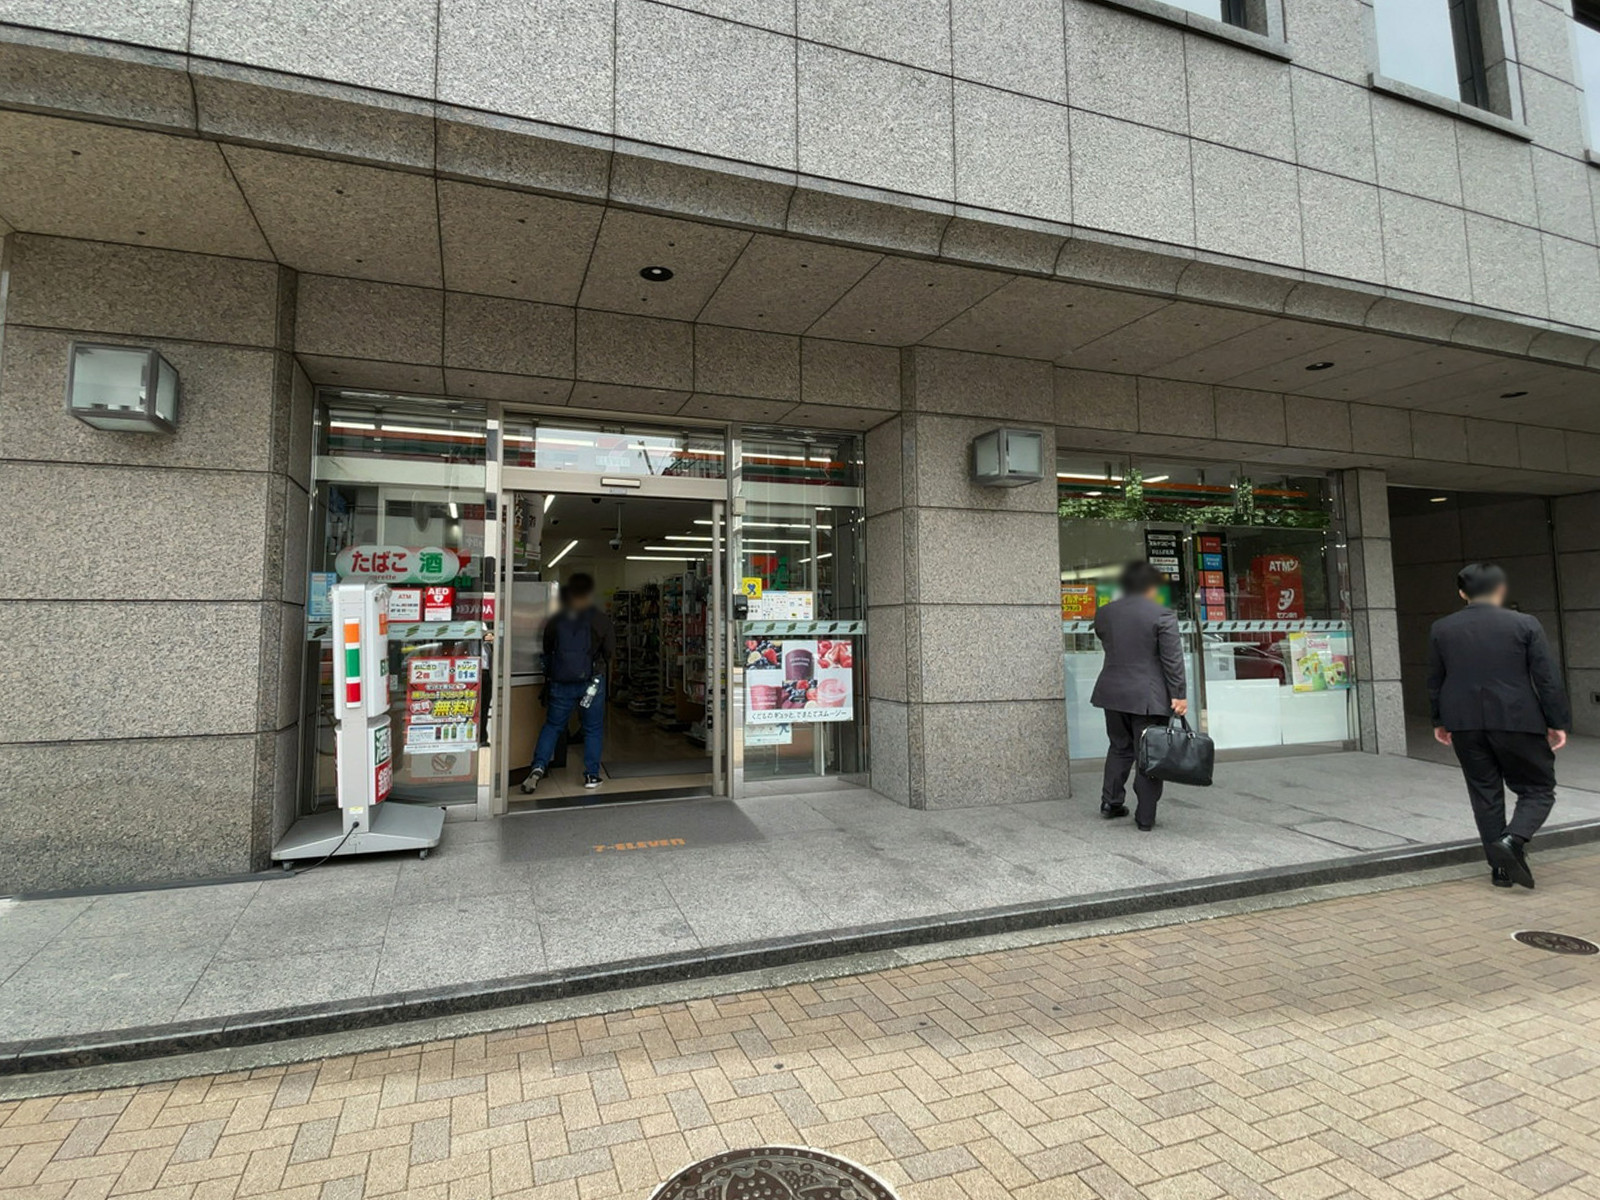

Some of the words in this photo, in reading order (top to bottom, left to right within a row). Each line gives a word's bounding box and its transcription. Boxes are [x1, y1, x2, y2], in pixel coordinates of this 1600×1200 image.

[352, 550, 408, 573] たばこ
[419, 551, 443, 573] 酒
[1269, 561, 1290, 572] ATM
